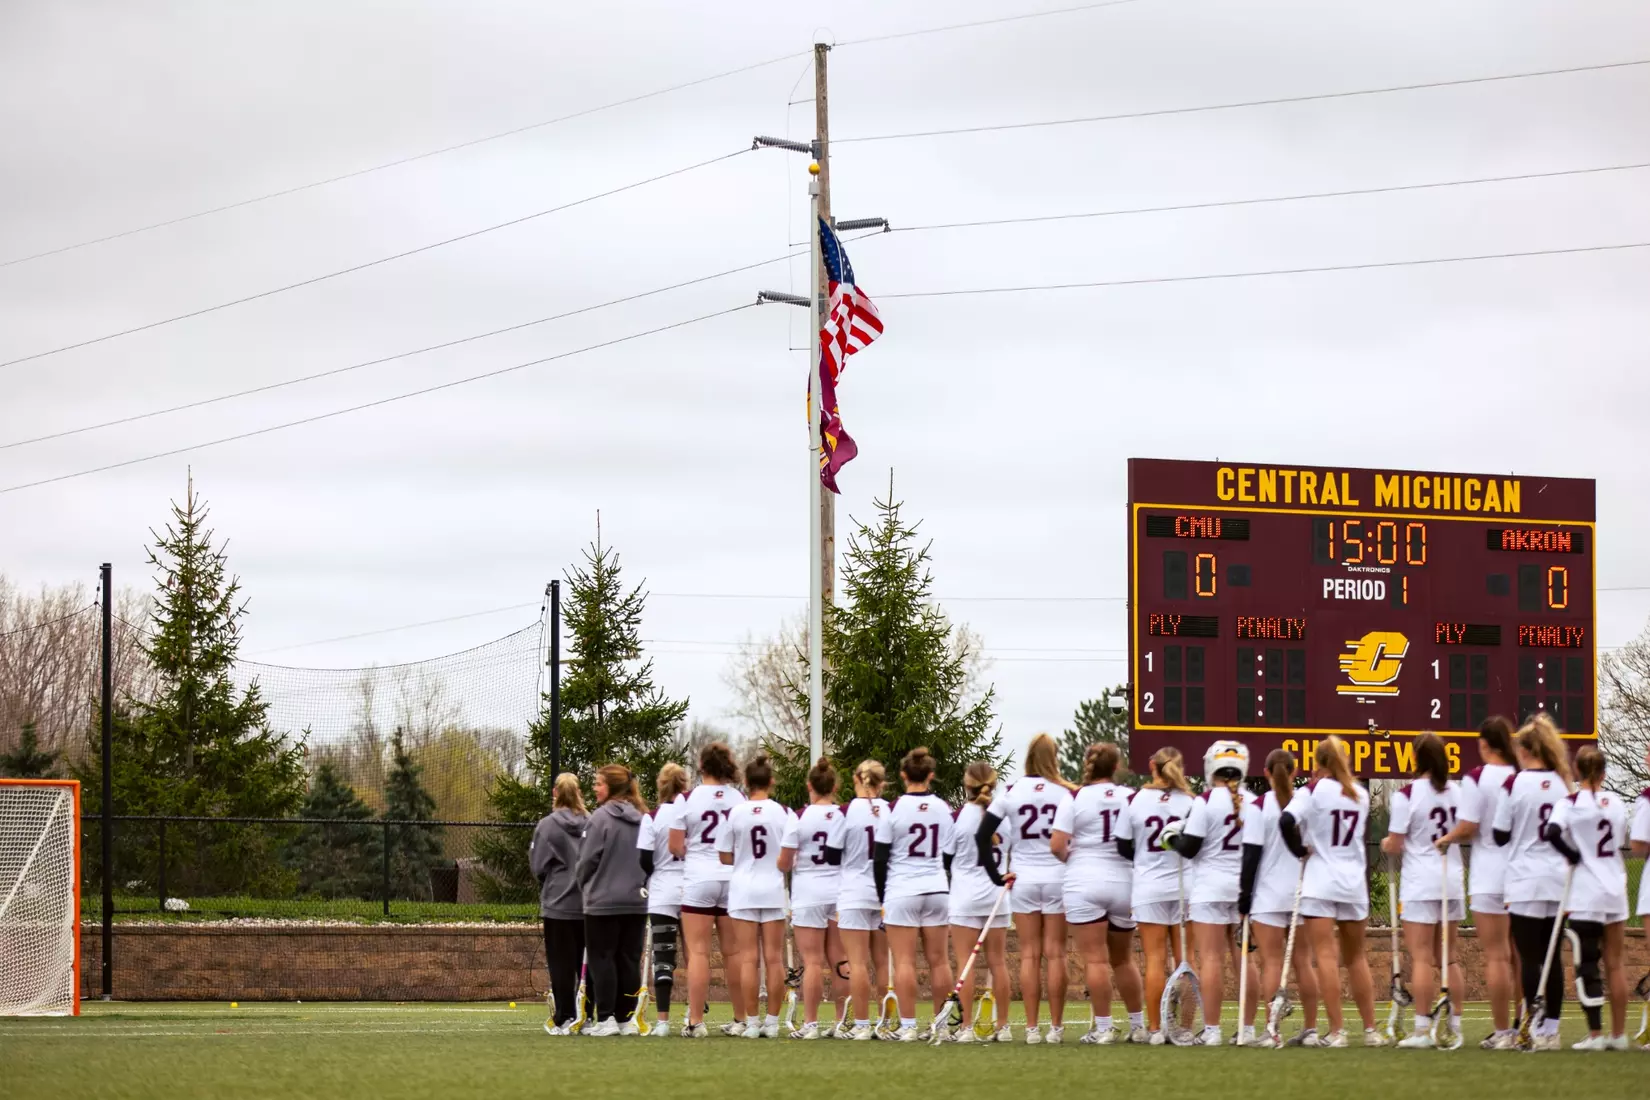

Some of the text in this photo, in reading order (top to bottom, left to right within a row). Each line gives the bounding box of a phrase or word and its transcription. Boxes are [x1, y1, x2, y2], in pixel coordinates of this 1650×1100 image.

[1216, 467, 1521, 513] CENTRAL MICHIGAN
[1175, 516, 1221, 538] CMU
[1329, 520, 1426, 565] 15:00
[1502, 529, 1572, 552] AKRON
[1195, 553, 1216, 597] 0
[1347, 566, 1391, 574] DAKTRONICS
[1323, 578, 1386, 600] PERIOD
[1402, 576, 1408, 605] 1
[1547, 566, 1568, 609] 0
[1150, 613, 1181, 635] PLY
[1237, 616, 1306, 639] PENALTY
[1435, 622, 1466, 644] PLY
[1518, 625, 1585, 648] PENALTY
[1144, 652, 1154, 673] 1
[1430, 659, 1440, 680] 1
[1143, 692, 1155, 713] 2
[1430, 698, 1441, 719] 2
[1282, 739, 1461, 773] CHPEWS
[1018, 803, 1058, 840] 23
[1330, 809, 1360, 847] 17
[750, 825, 767, 859] 6
[908, 822, 940, 858] 21
[1597, 819, 1614, 857] 2
